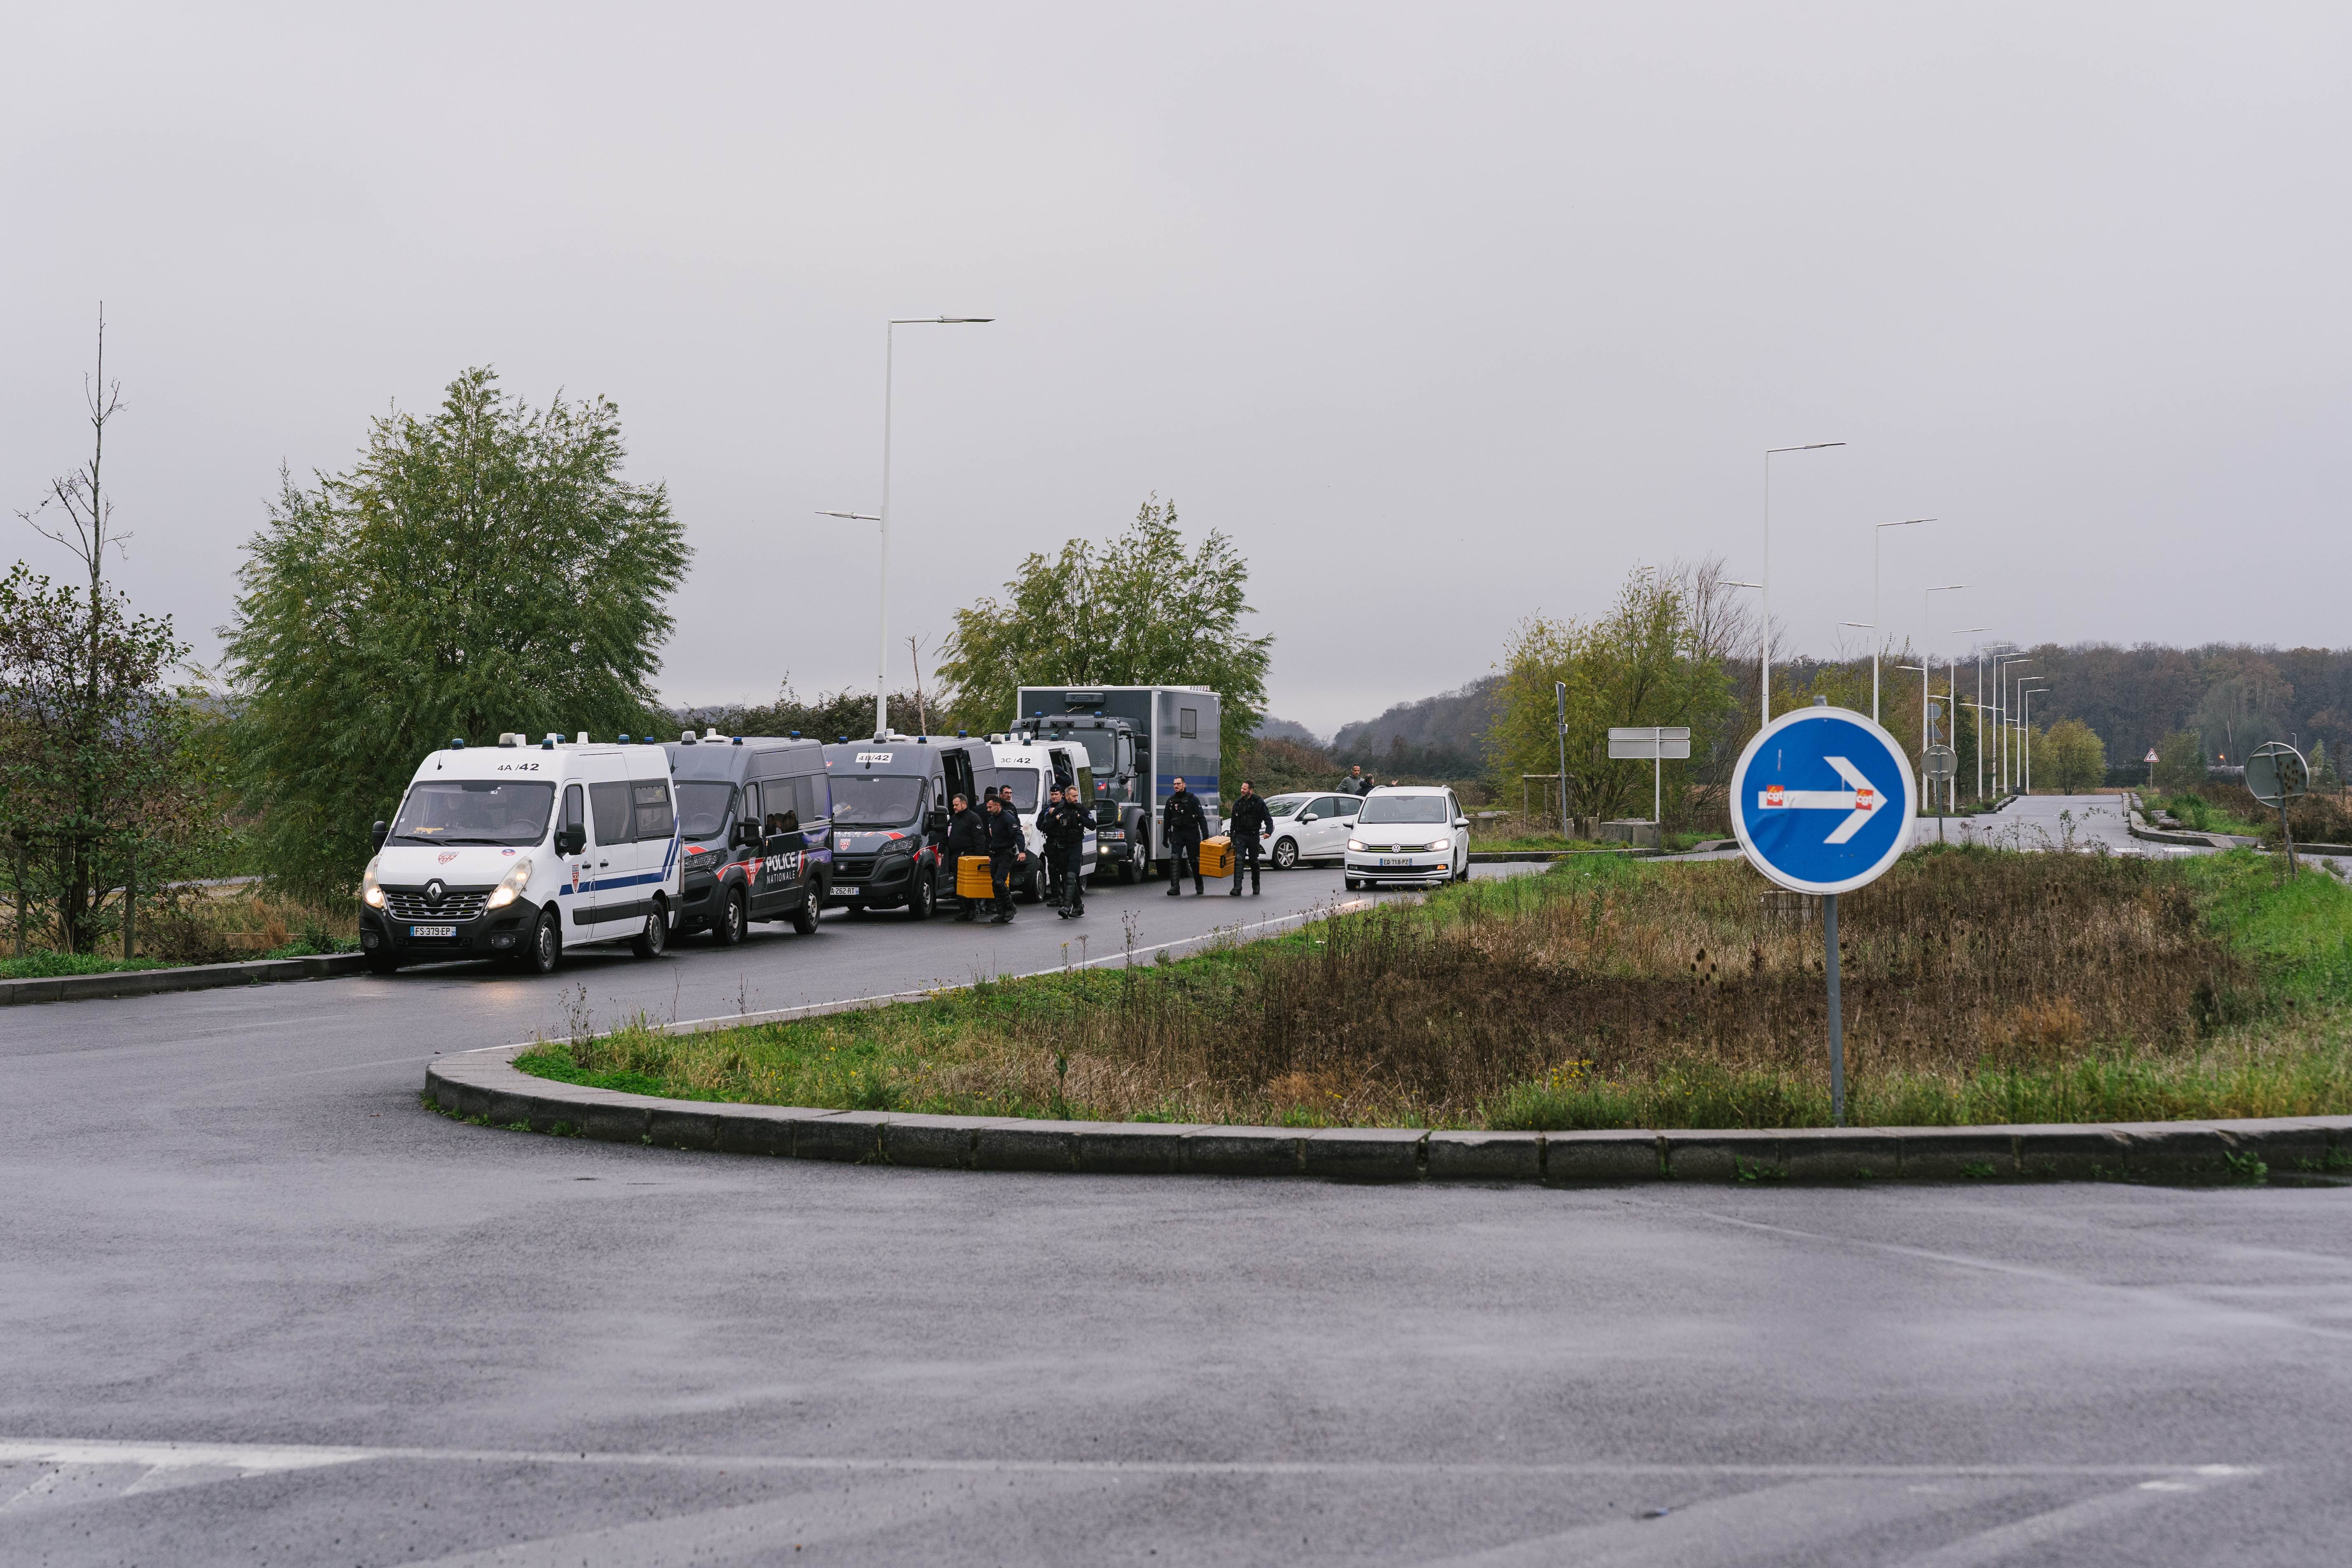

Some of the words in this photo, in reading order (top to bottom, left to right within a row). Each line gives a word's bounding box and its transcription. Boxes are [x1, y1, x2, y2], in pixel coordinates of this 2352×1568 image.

[1767, 791, 1784, 802] cgt
[1856, 795, 1873, 806] cgt
[766, 851, 796, 872] POLICE
[767, 870, 795, 884] NATIONALE
